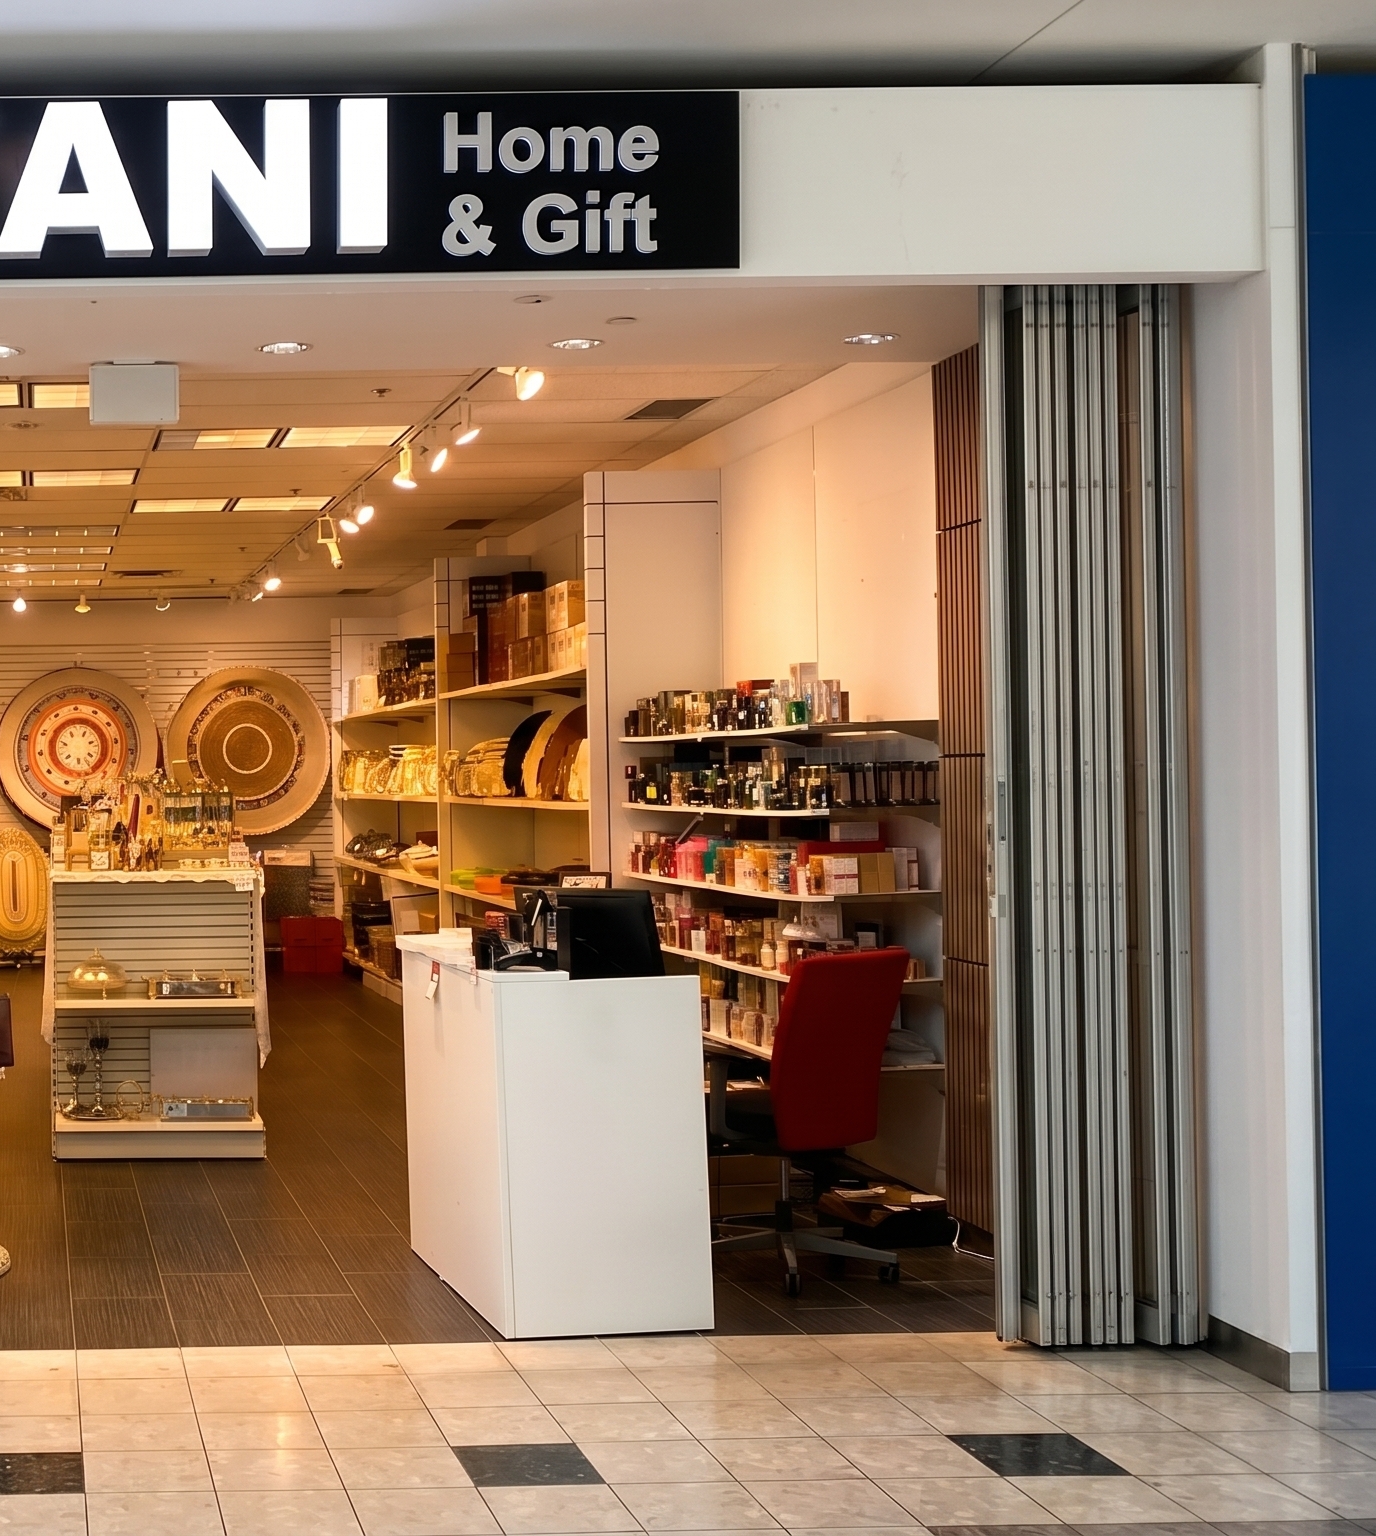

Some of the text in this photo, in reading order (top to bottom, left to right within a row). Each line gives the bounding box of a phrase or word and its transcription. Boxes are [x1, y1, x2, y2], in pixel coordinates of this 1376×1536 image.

[443, 111, 660, 174] Home
[441, 190, 659, 257] & Gift
